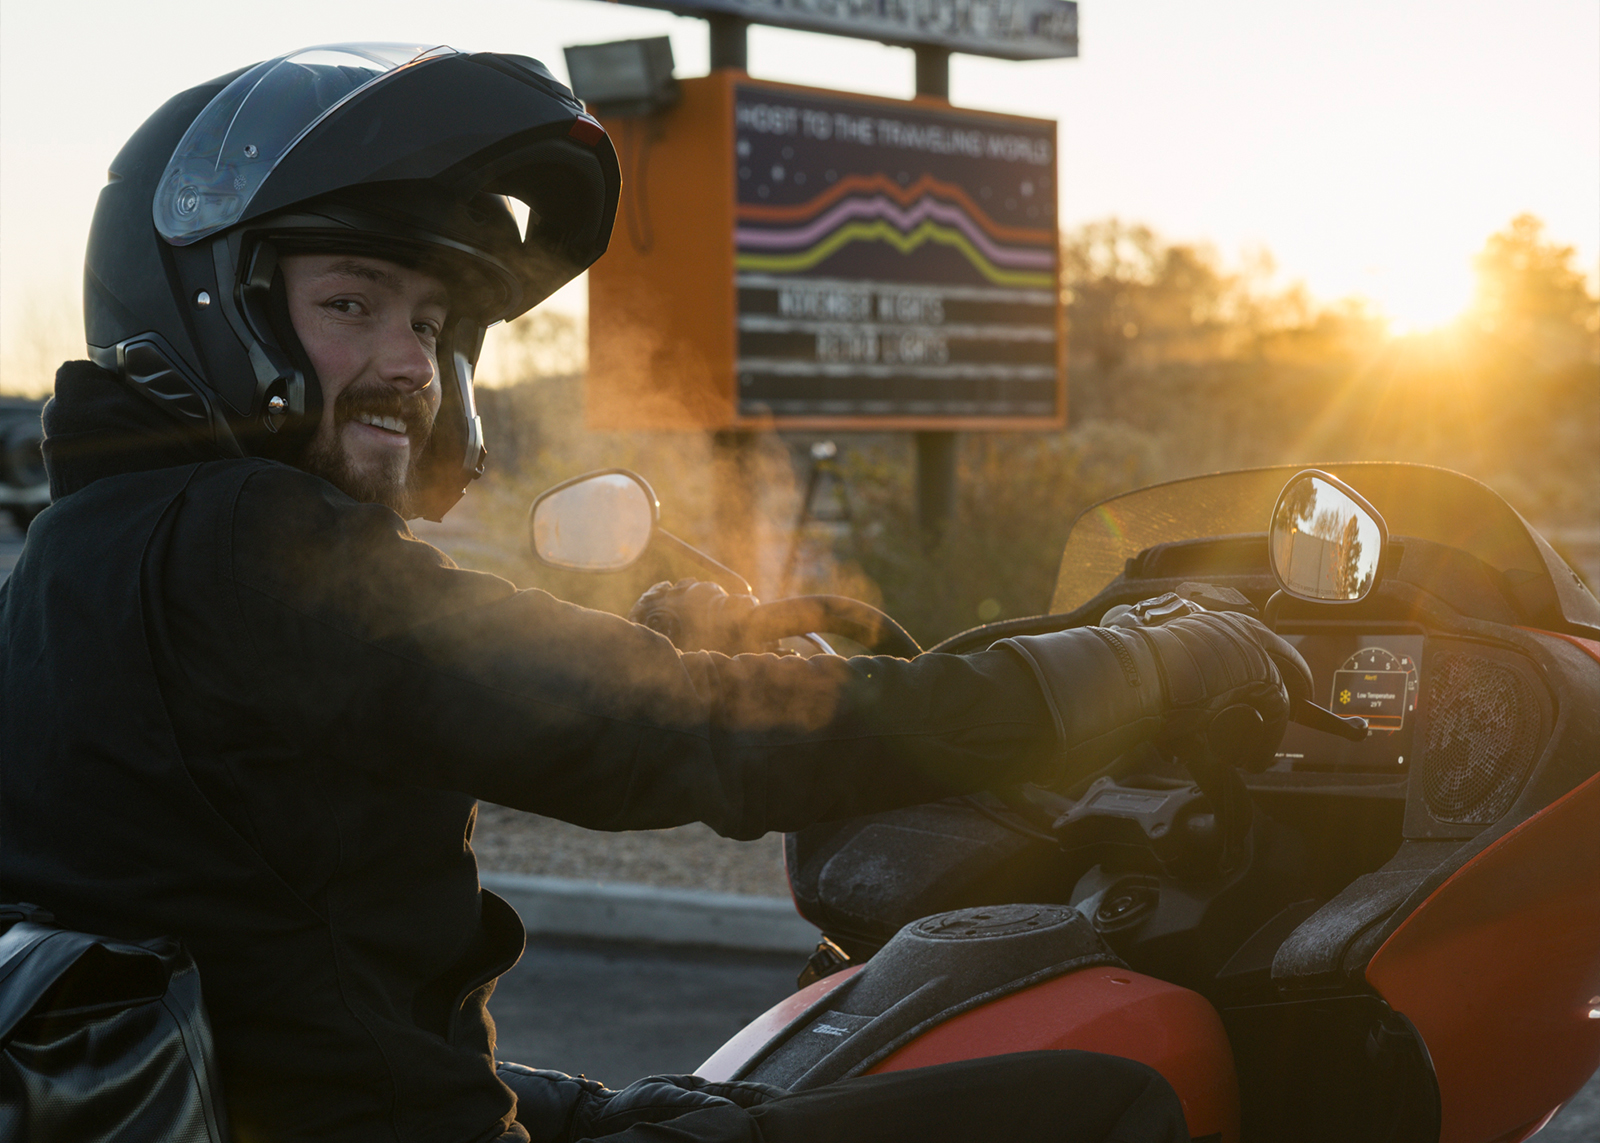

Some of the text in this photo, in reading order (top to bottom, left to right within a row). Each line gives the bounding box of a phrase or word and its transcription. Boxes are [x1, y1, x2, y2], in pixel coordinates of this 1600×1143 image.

[736, 104, 1052, 166] HOST TO THE TRAVELING WORLD
[778, 289, 944, 324] NOVEMBER NIGHTS
